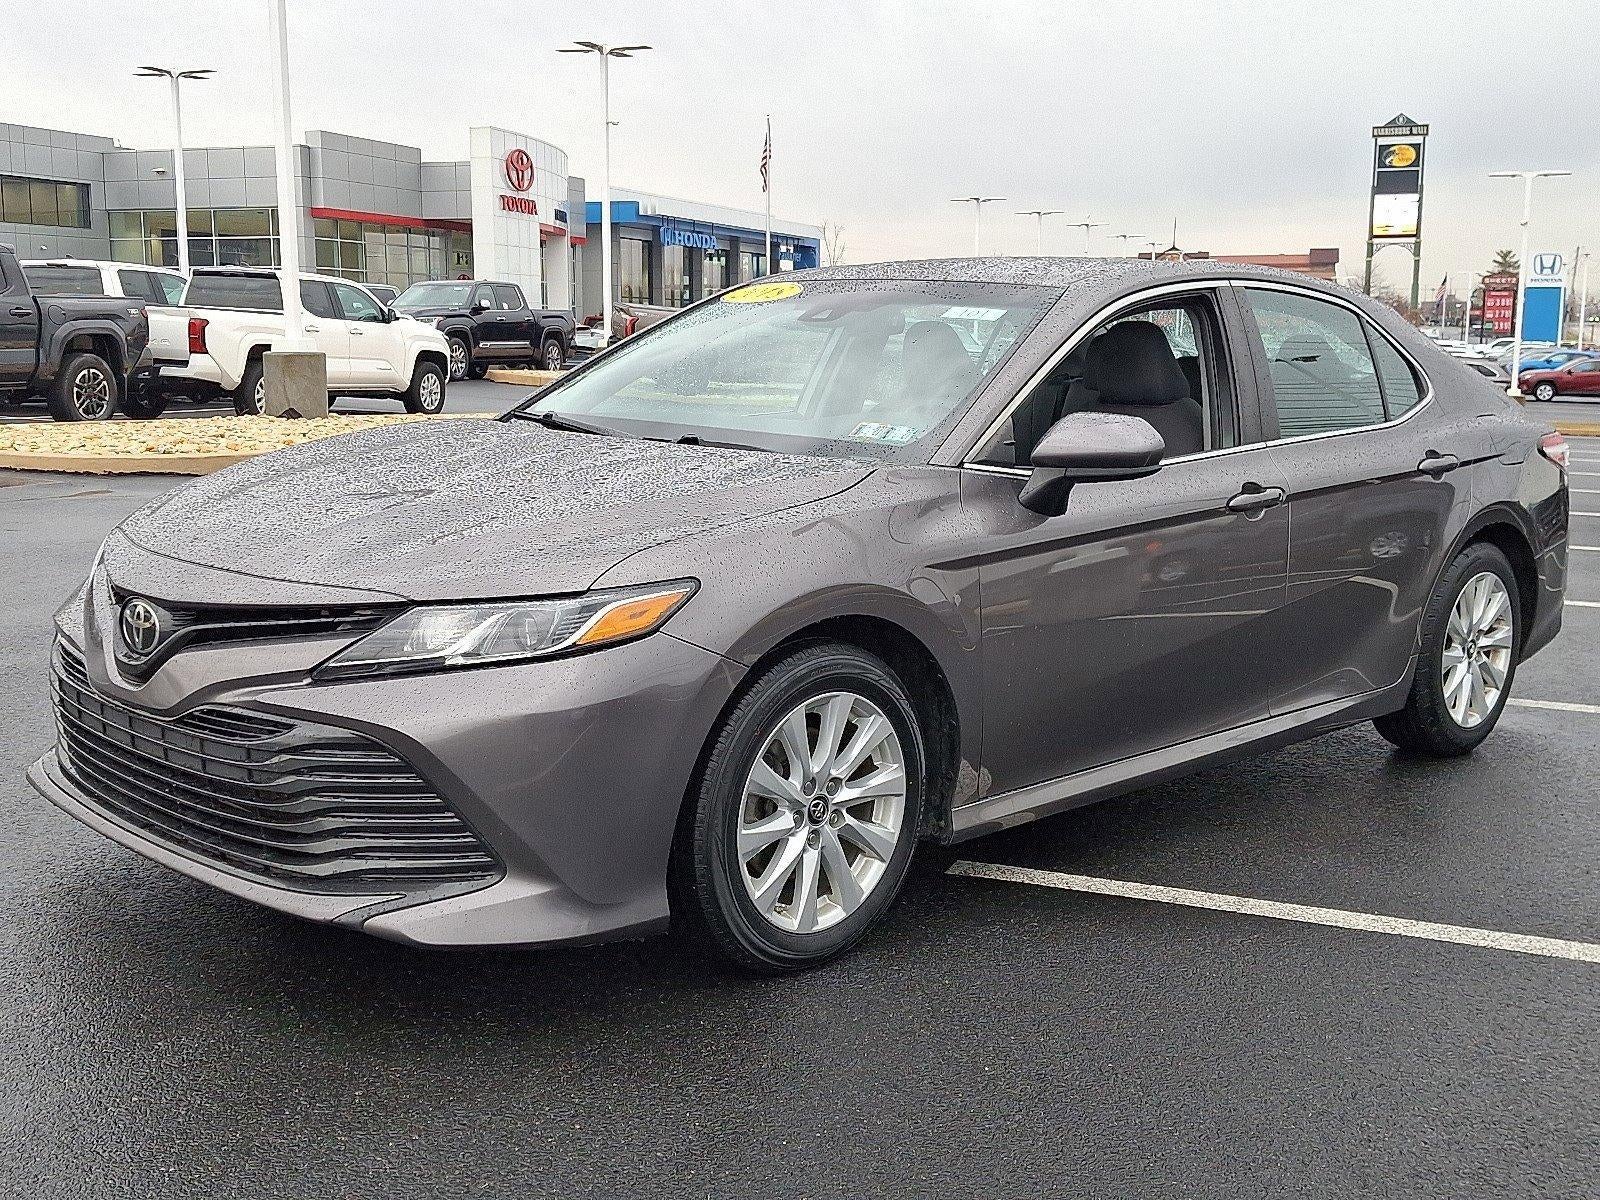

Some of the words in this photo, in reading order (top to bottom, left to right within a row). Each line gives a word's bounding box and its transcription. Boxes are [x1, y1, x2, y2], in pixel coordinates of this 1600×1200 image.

[1413, 126, 1427, 134] MALL
[500, 195, 538, 215] TOYOTA
[673, 230, 719, 250] HONDA
